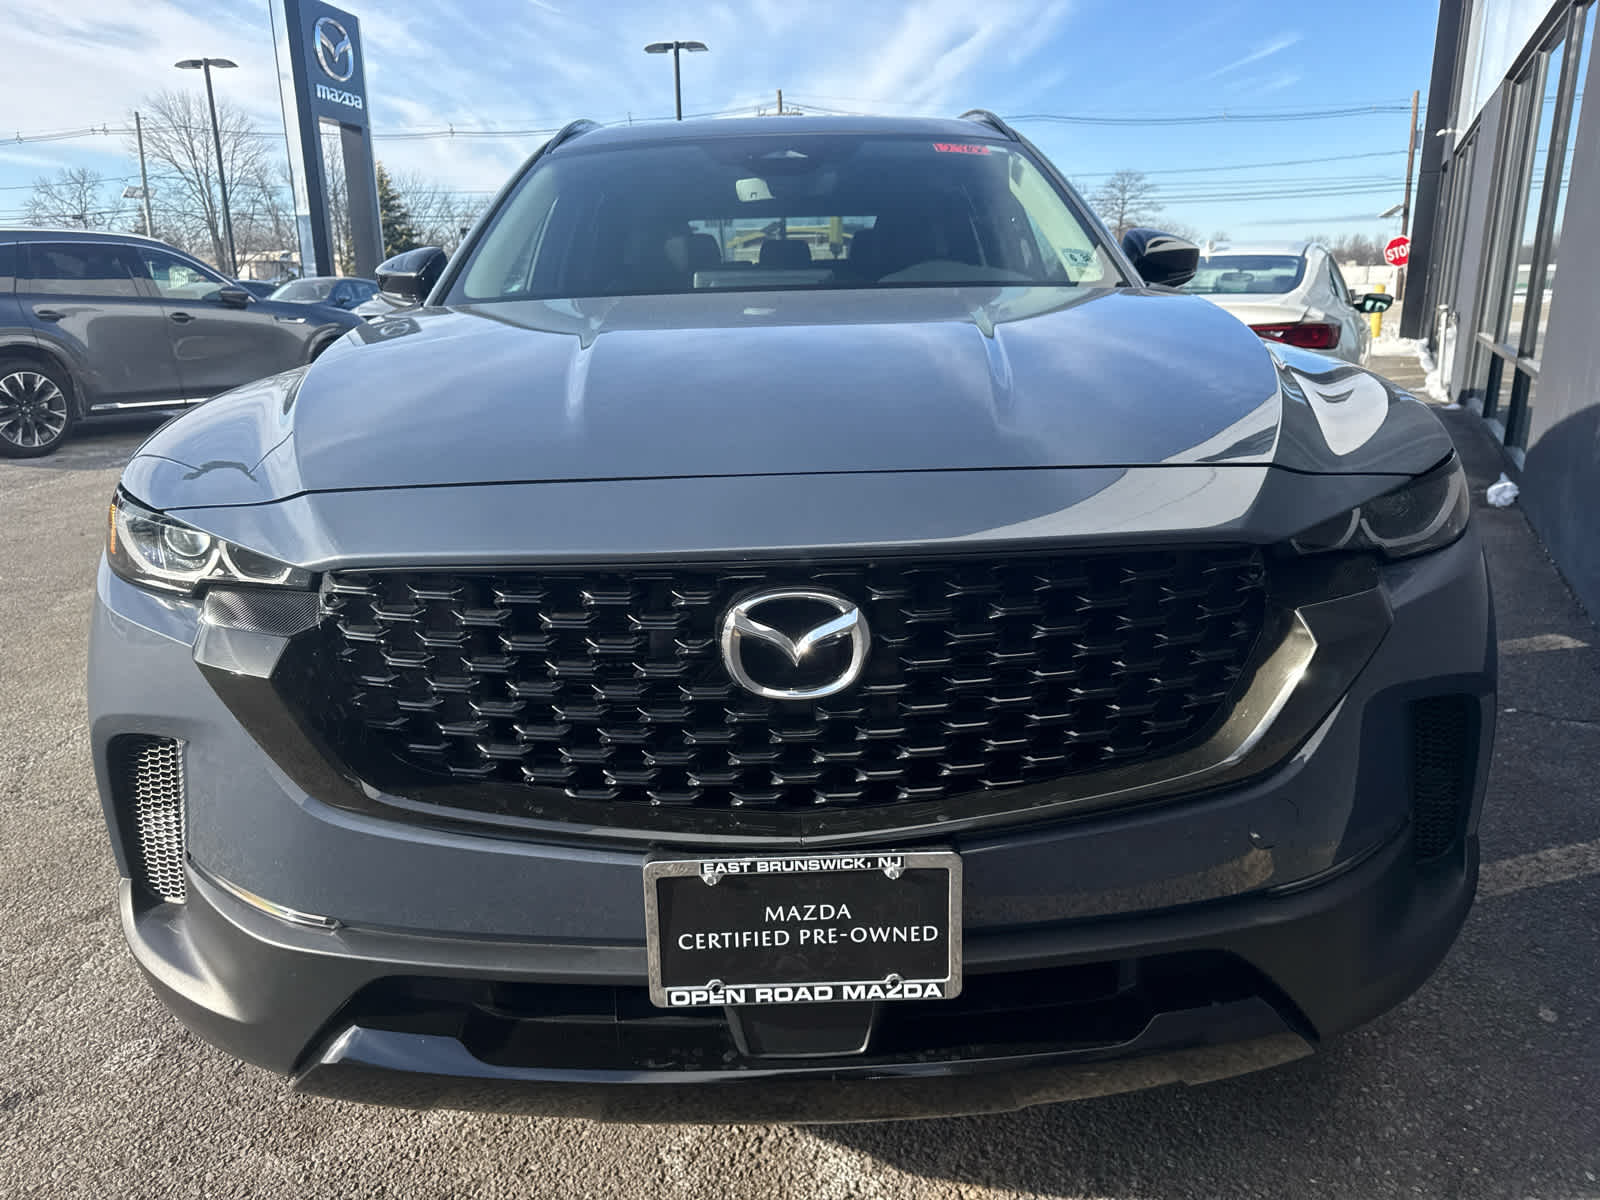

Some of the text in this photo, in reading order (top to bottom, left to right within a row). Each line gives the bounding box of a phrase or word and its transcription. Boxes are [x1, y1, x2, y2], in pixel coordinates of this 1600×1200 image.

[703, 856, 902, 873] EAST BRUNSWICK, NJ
[764, 904, 852, 922] MAZDA
[678, 925, 939, 950] CERTIFIED PRE-OWNED
[670, 983, 943, 1006] OPEN ROAD MAZDA
